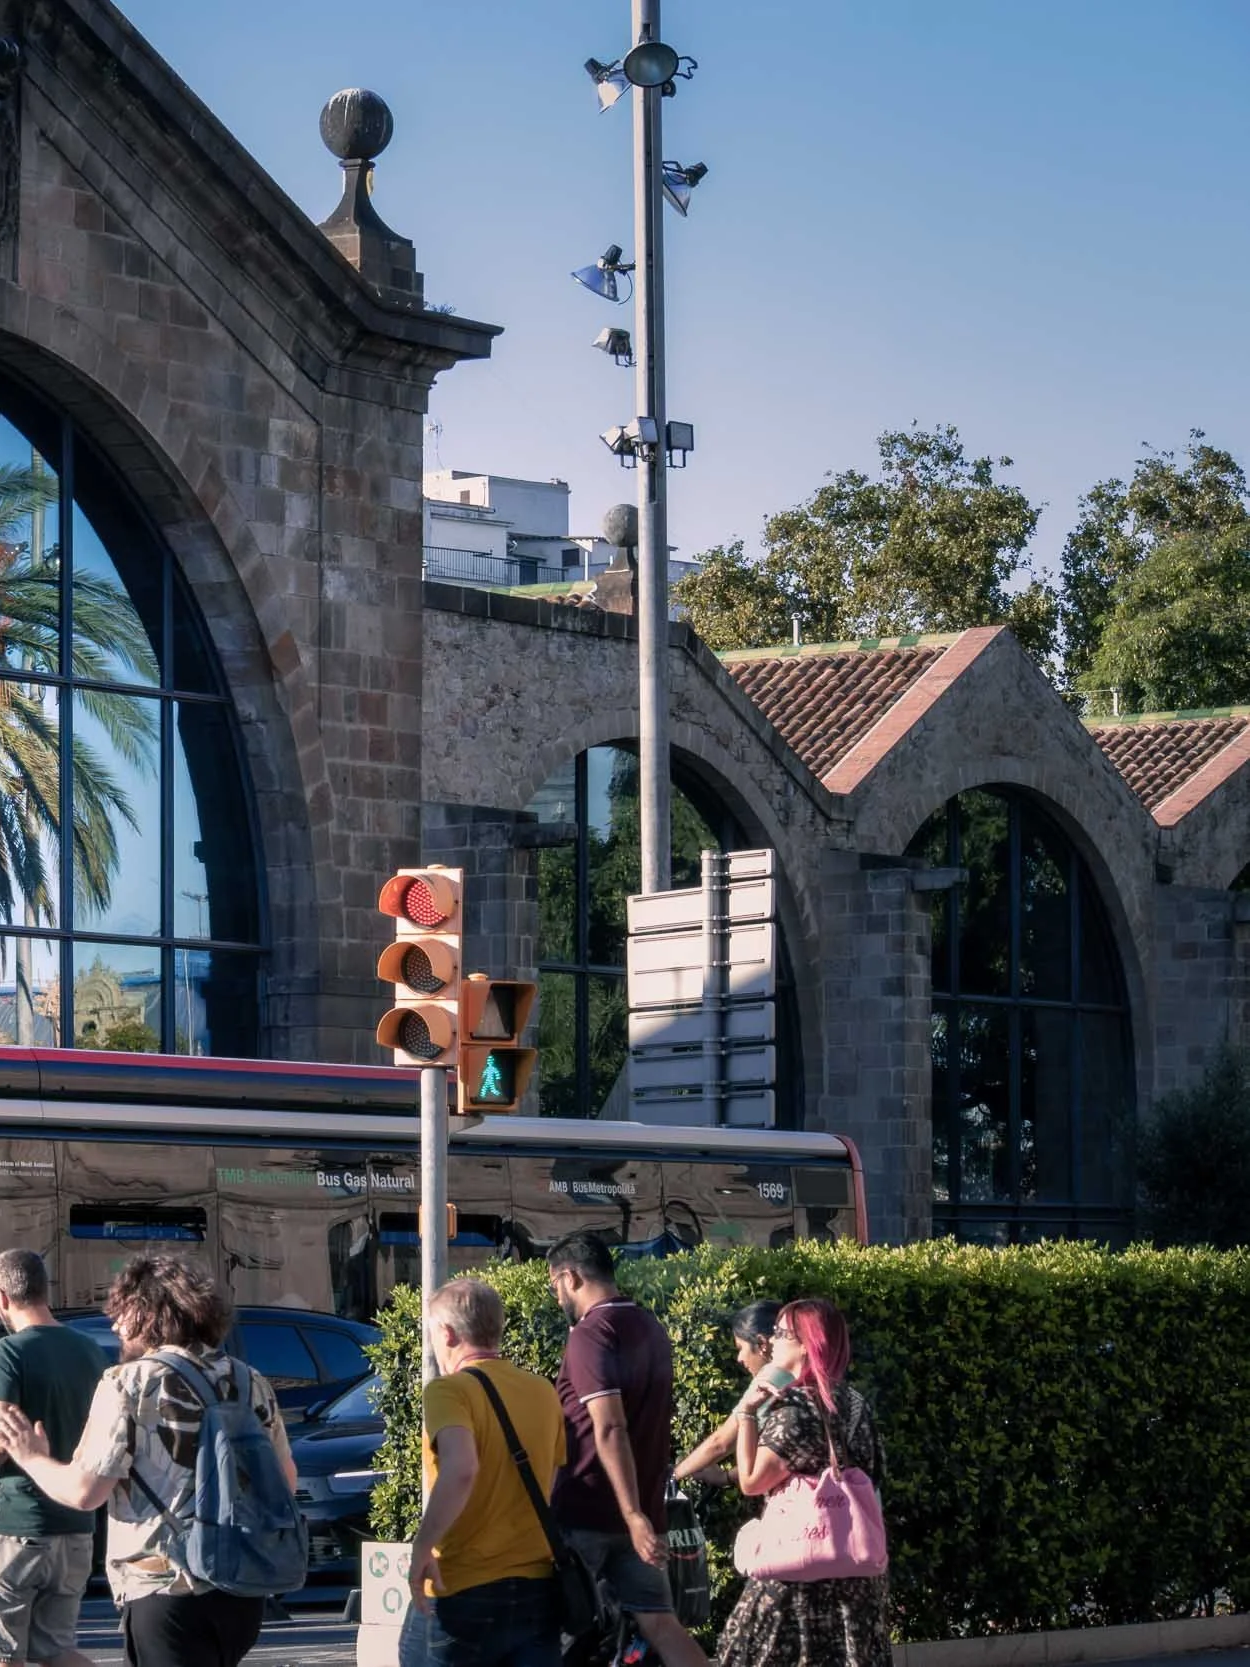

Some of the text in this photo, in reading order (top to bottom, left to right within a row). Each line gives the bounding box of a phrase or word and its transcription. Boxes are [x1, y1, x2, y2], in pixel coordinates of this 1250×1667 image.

[216, 1168, 243, 1184] TMB
[317, 1171, 341, 1187] Bus
[344, 1172, 367, 1187] Gas
[370, 1173, 415, 1189] Natural
[549, 1180, 568, 1193] AMB
[757, 1183, 784, 1199] 1569
